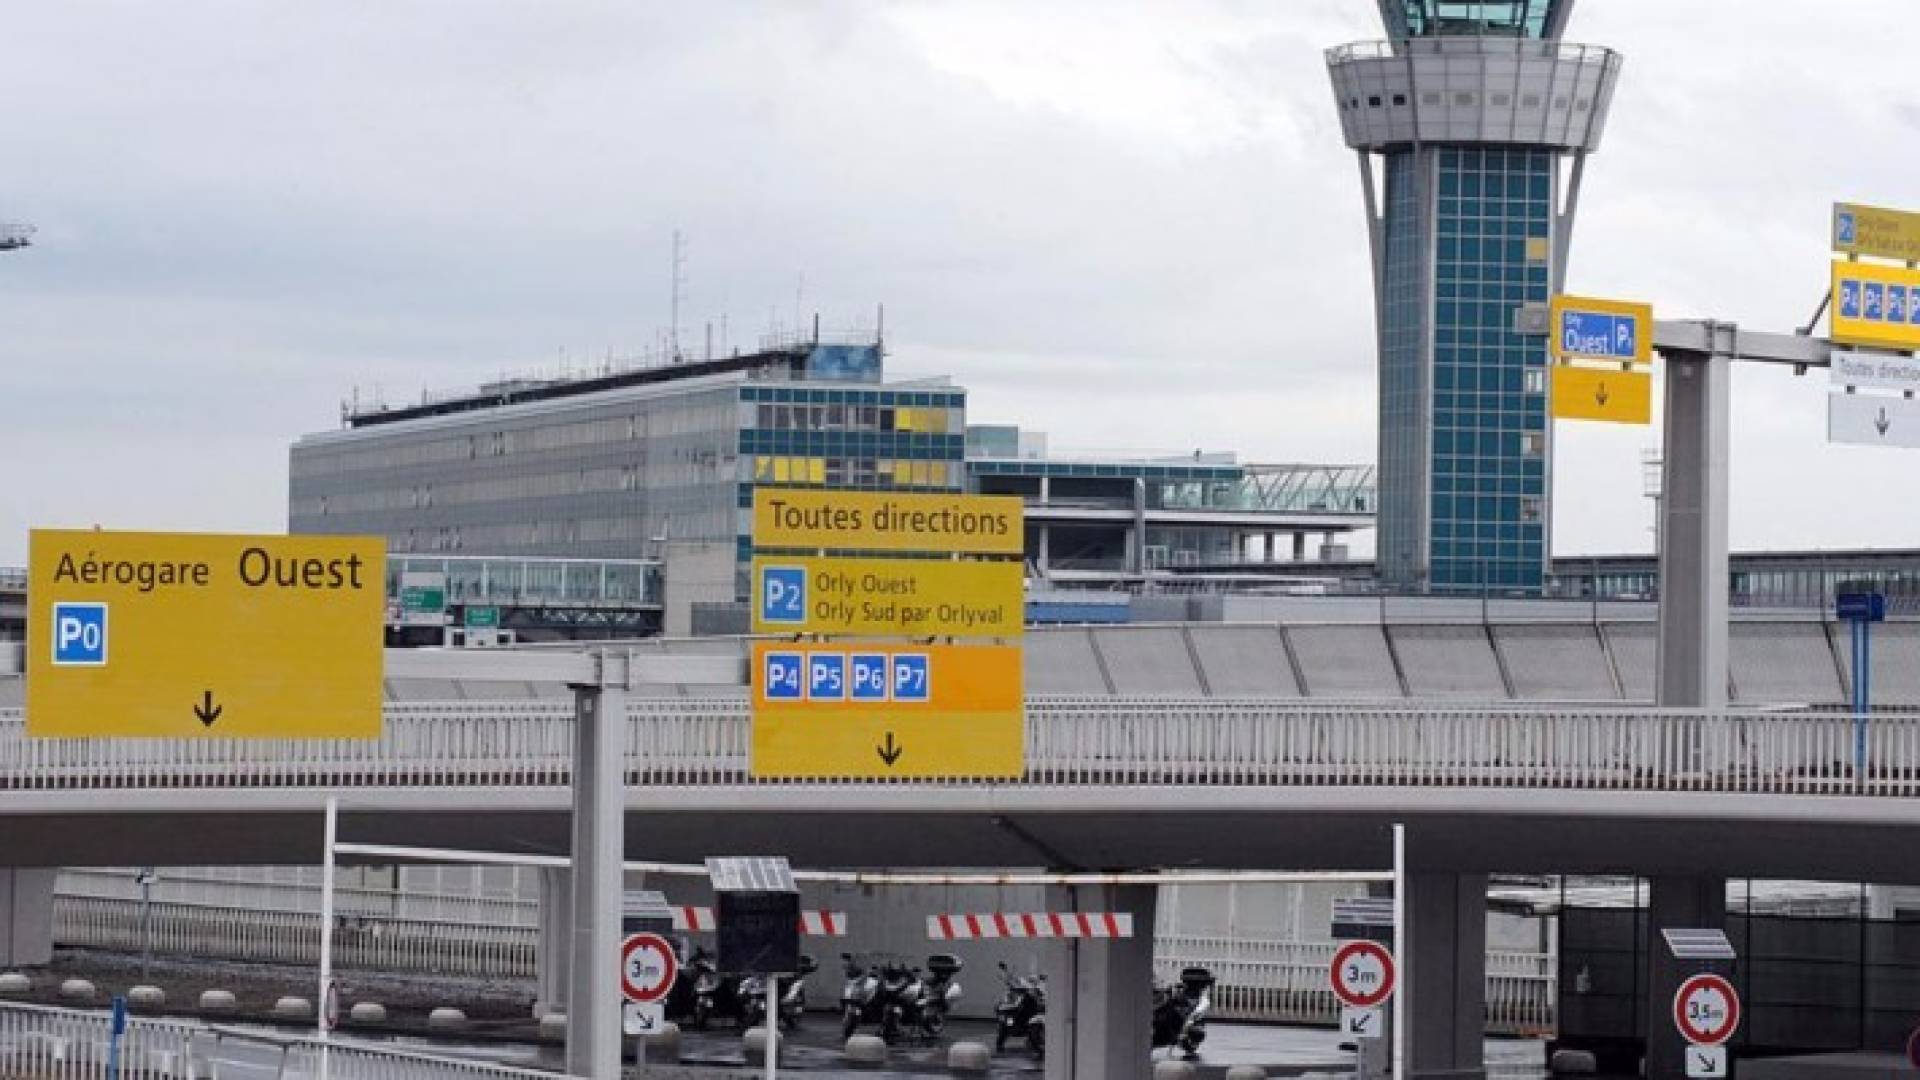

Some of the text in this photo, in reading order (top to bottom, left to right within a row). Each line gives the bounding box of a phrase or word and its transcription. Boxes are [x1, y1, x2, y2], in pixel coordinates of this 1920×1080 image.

[1566, 327, 1608, 355] Ouest
[770, 500, 1008, 536] Toutes directions
[53, 547, 363, 592] Aérogare Ouest
[766, 579, 801, 611] P2
[815, 572, 917, 596] Orly Ouest
[815, 601, 1003, 627] Orly Sud par Orlyval
[769, 663, 798, 690] P4
[812, 663, 841, 690] P5
[855, 663, 884, 690] P6
[895, 664, 925, 690] P7
